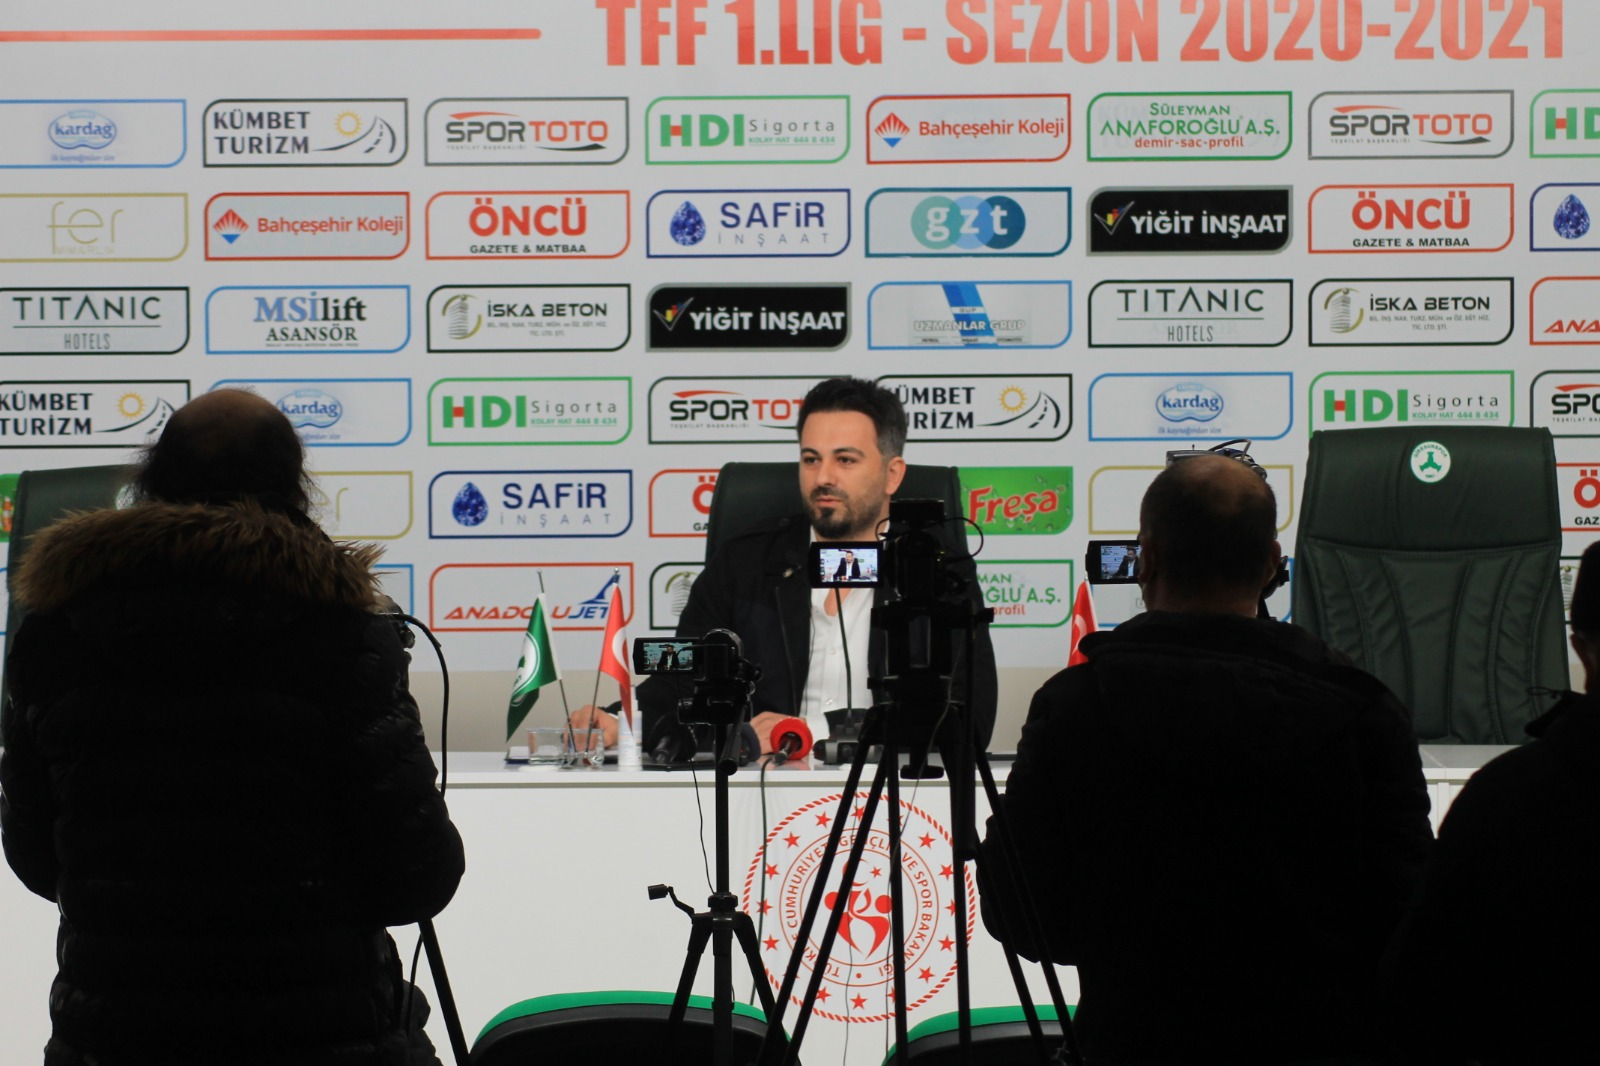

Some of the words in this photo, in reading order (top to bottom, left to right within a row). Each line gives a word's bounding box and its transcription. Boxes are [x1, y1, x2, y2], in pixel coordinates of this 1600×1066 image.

[595, 0, 708, 66] TFF
[946, 0, 1159, 65] SEZON
[1180, 0, 1563, 62] 2020-2021
[213, 109, 310, 130] KÜMBET
[1149, 102, 1231, 116] SÜLEYMAN
[660, 114, 745, 147] HDI
[749, 119, 835, 136] Sigorta
[919, 120, 1014, 139] Bahçeşehir
[1018, 118, 1065, 138] Koleji
[1100, 117, 1240, 138] ANAFOROĞLU
[1245, 119, 1281, 137] A.Ş.
[213, 134, 310, 154] TURİZM
[1134, 135, 1245, 149] demir-sac-profil
[469, 197, 587, 237] ÖNCÜ
[1352, 191, 1470, 230] ÖNCÜ
[257, 217, 353, 236] Bahçeşehir
[357, 215, 403, 234] Koleji
[925, 205, 1008, 242] gzt
[1131, 210, 1194, 234] YİĞİT
[1201, 210, 1286, 238] İNŞAAT
[470, 245, 518, 254] GAZETE
[523, 245, 531, 253] &
[536, 244, 587, 253] MATBAA
[717, 232, 829, 247] İNŞAAT
[1353, 238, 1401, 247] GAZETE
[1406, 238, 1414, 247] &
[1419, 237, 1470, 247] MATBAA
[12, 294, 161, 321] TITANIC
[487, 300, 535, 317] İSKA
[542, 303, 607, 317] BETON
[1116, 286, 1264, 312] TITANIC
[1370, 294, 1417, 311] İSKA
[1424, 297, 1490, 311] BETON
[689, 306, 752, 330] YİĞİT
[760, 306, 845, 335] İNŞAAT
[914, 320, 986, 331] UZMANLAR
[990, 320, 1025, 331] GRUP
[64, 333, 111, 350] HOTELS
[265, 323, 358, 341] ASANSÖR
[1168, 325, 1214, 342] HOTELS
[895, 384, 975, 404] ÜMBET
[443, 396, 526, 428] HDI
[531, 400, 617, 416] Sigorta
[1324, 389, 1408, 422] HDI
[1413, 394, 1499, 410] Sigorta
[0, 414, 91, 435] TURİZM
[906, 408, 974, 429] RİZM
[966, 486, 1060, 526] Freşa
[500, 513, 610, 528] İNŞAAT
[1574, 517, 1600, 526] GAZ
[902, 852, 918, 871] VE
[914, 871, 933, 909] SPOR
